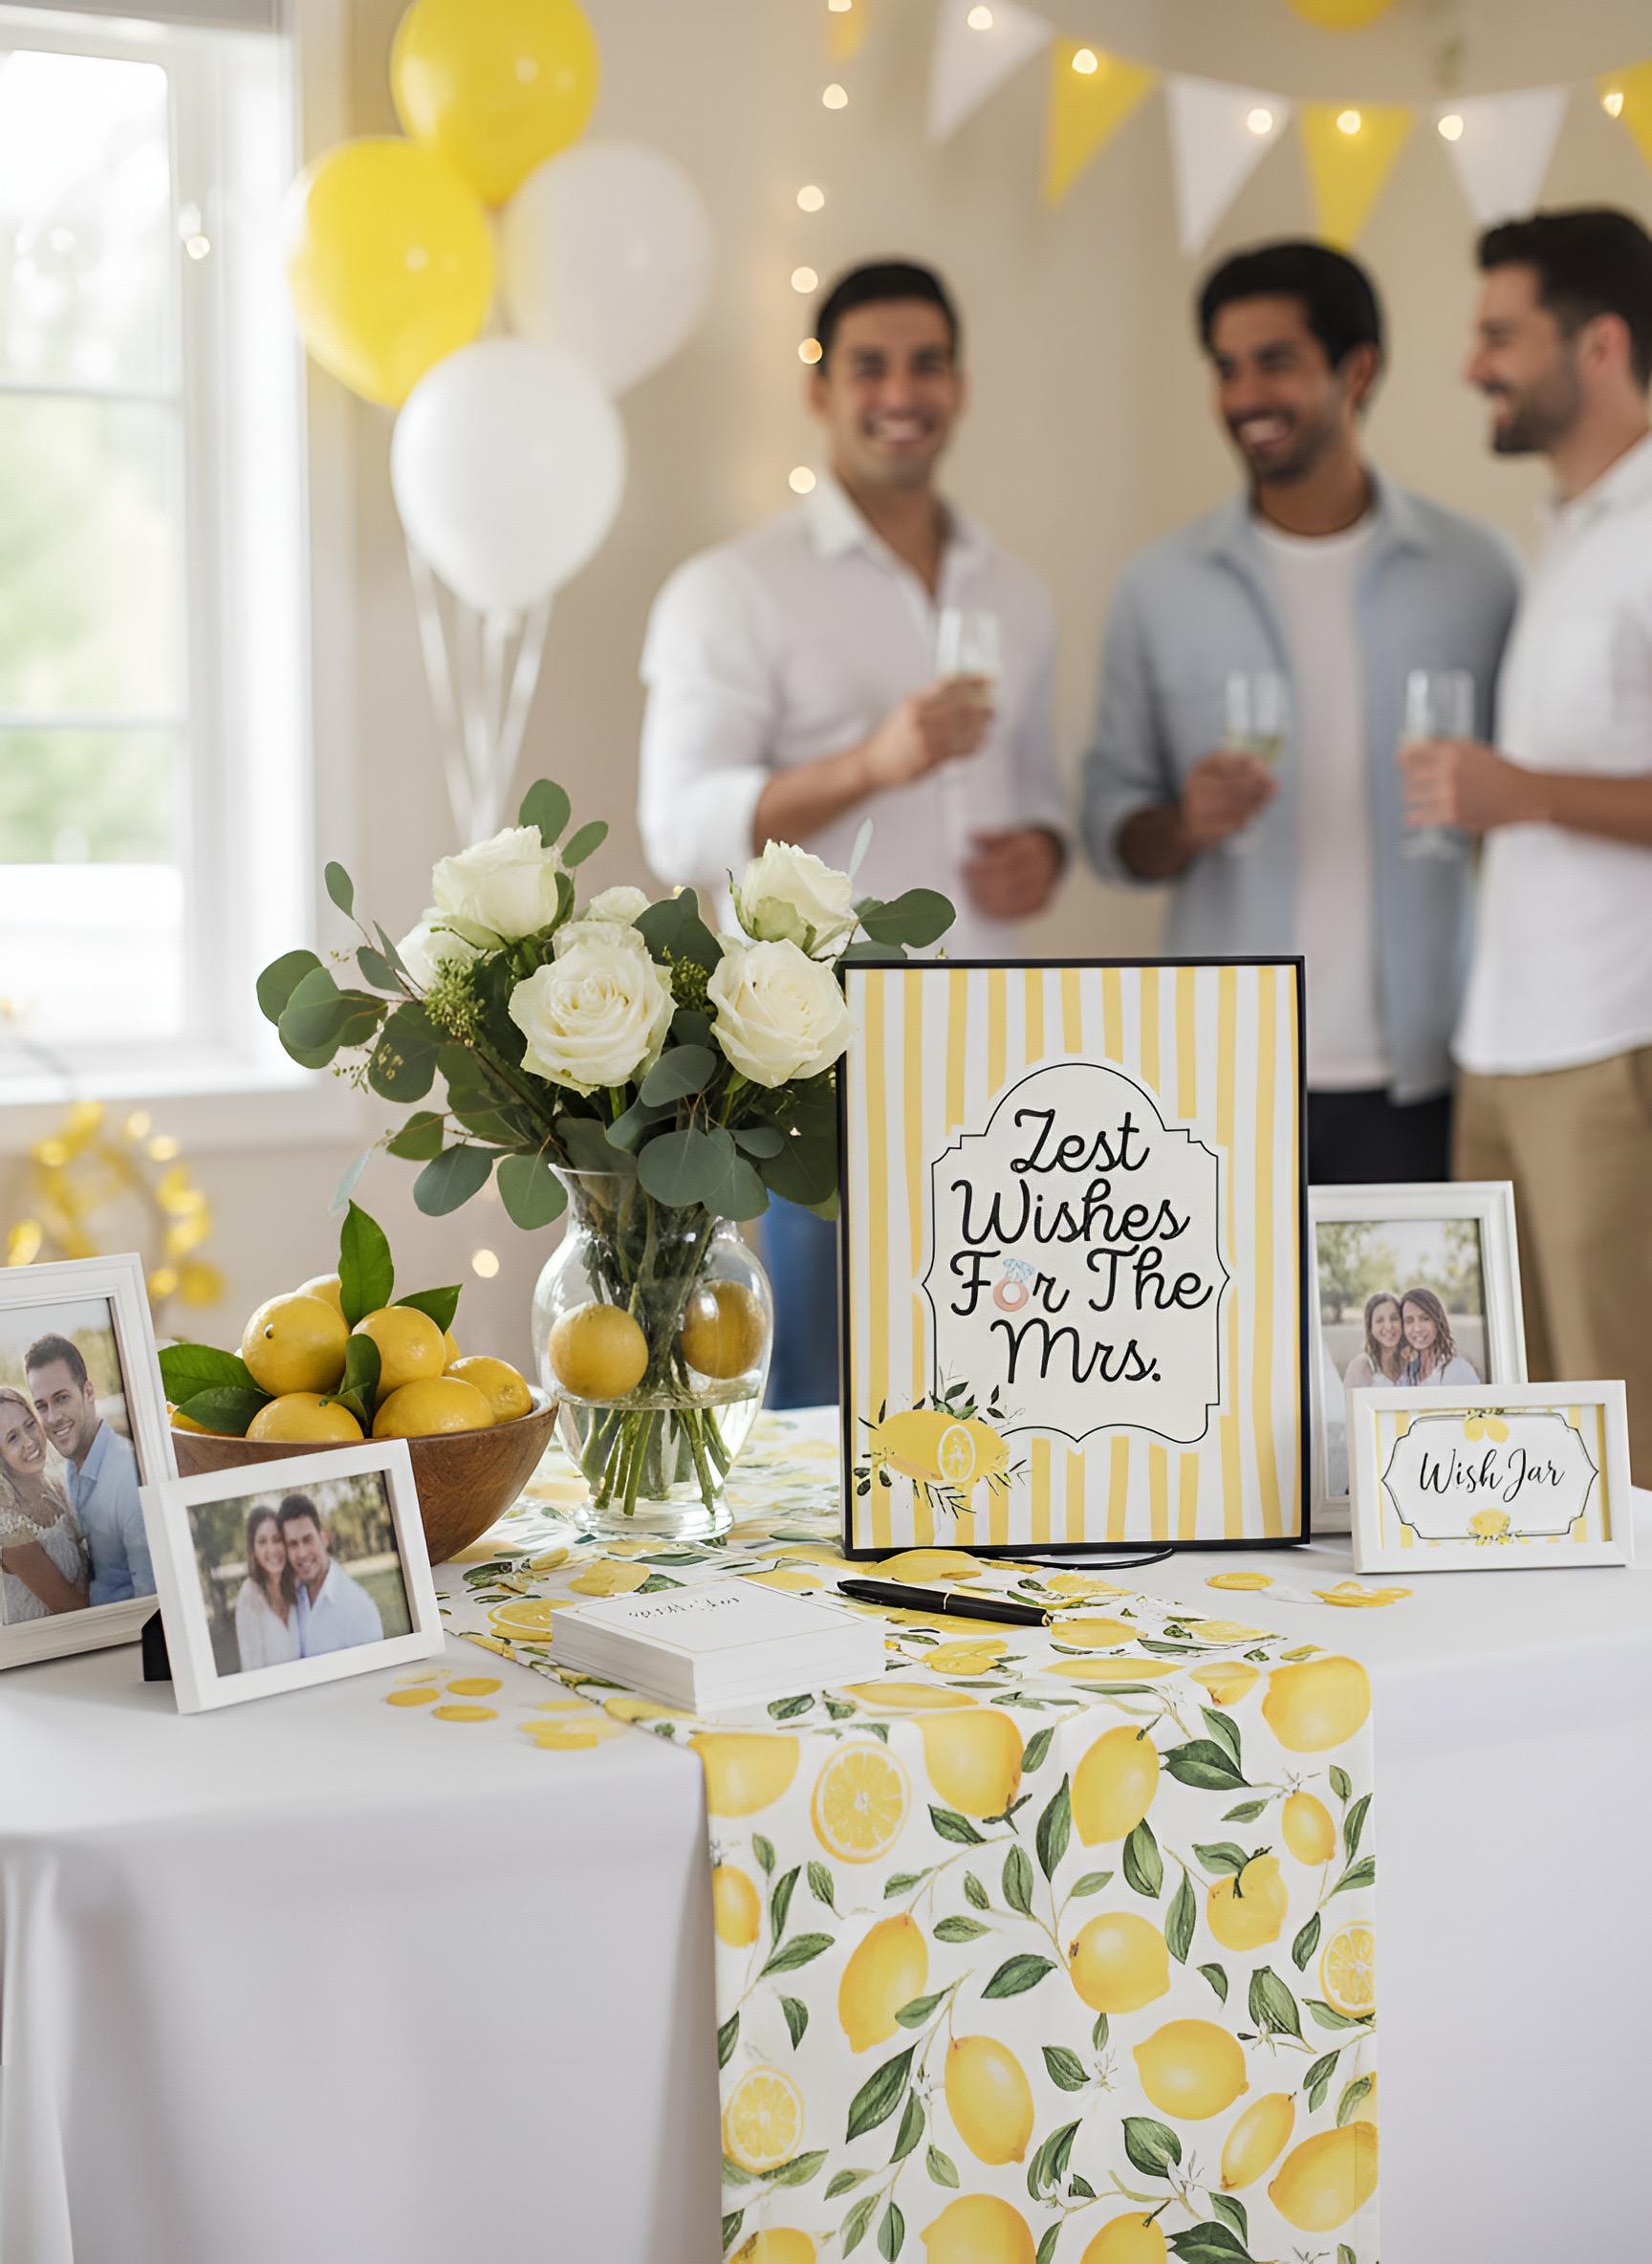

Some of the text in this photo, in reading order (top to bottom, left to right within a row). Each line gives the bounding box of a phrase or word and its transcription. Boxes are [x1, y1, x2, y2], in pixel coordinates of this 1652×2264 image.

[1010, 1108, 1150, 1173] Zest
[950, 1177, 1191, 1245] Wishes
[1086, 1244, 1214, 1312] The
[989, 1317, 1162, 1384] Mrs.
[1419, 1448, 1565, 1503] Wish Jar
